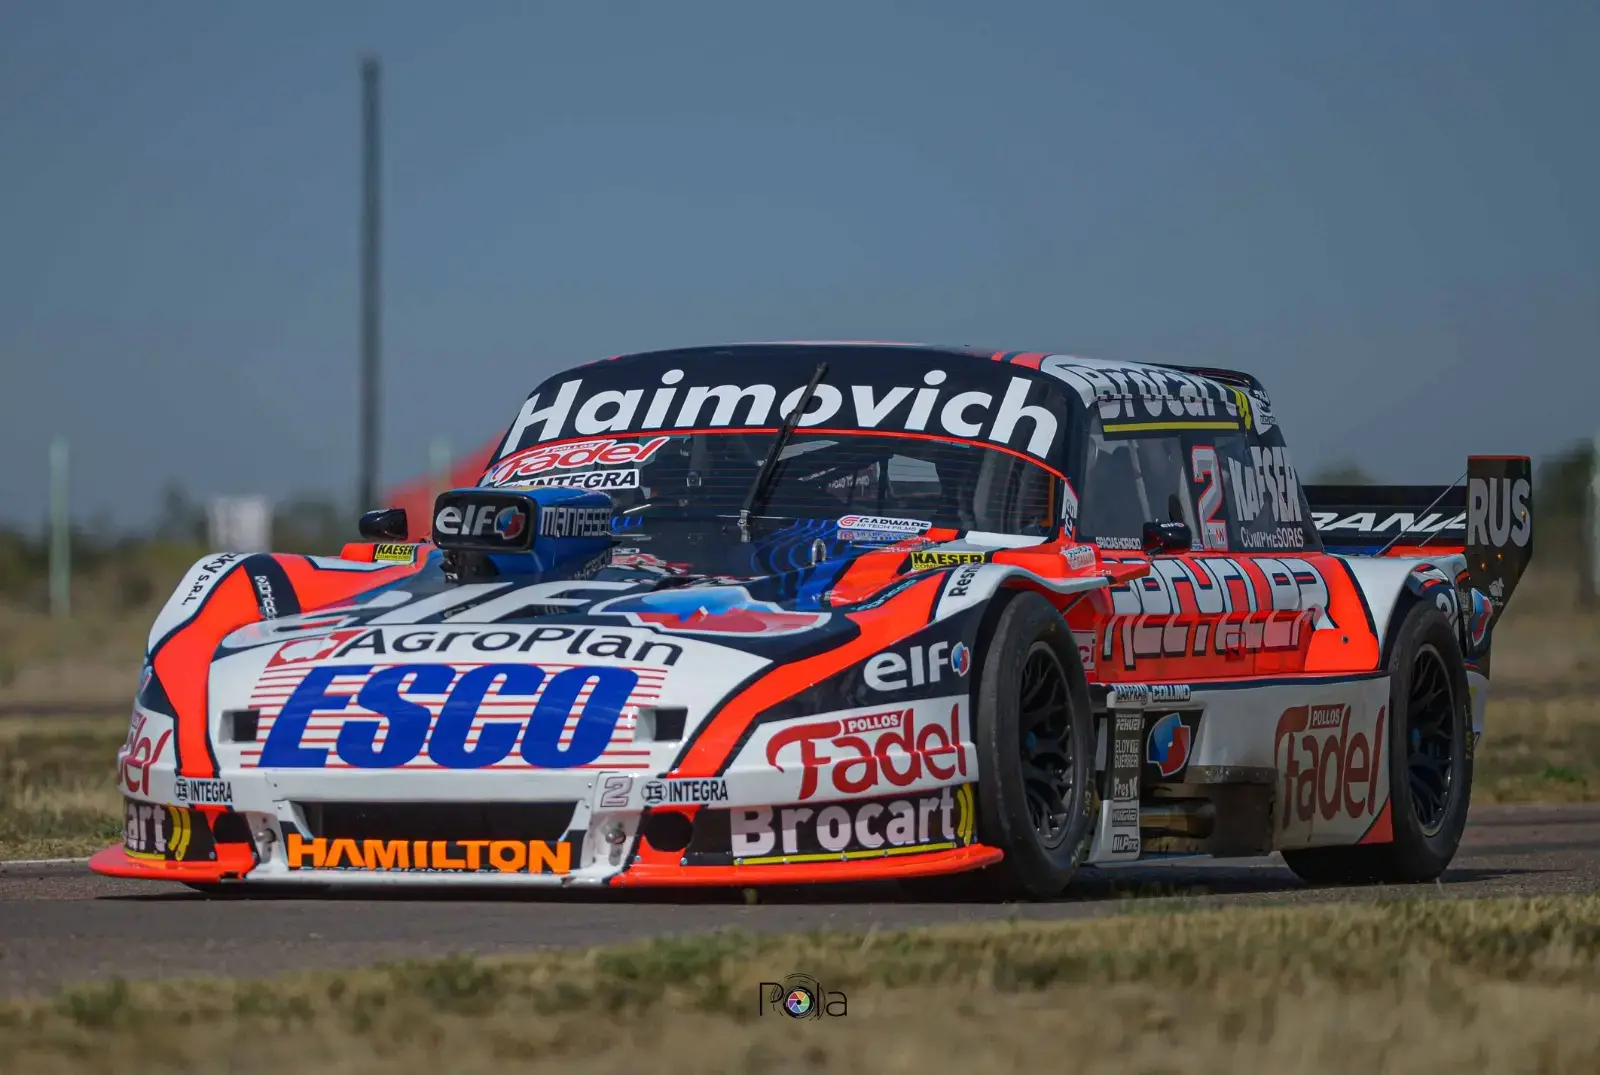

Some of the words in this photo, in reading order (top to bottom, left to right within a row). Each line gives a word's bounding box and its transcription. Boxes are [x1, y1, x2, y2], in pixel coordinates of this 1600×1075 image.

[500, 369, 1058, 459] Haimovich
[492, 437, 668, 481] Fadel
[1191, 445, 1229, 551] 2
[1467, 477, 1531, 547] RUS
[436, 505, 496, 536] elf
[333, 628, 684, 666] AgroPlan
[864, 641, 949, 692] elf
[257, 663, 640, 768] ESCO
[847, 714, 900, 732] POLLOS
[1312, 708, 1341, 725] POLLOS
[766, 703, 967, 800] Fadel
[1275, 704, 1385, 829] Fadel
[190, 782, 233, 802] INTEGRA
[600, 776, 633, 808] 2
[669, 780, 729, 802] INTEGRA
[730, 787, 955, 857] Brocart
[288, 833, 571, 875] HAMILTON
